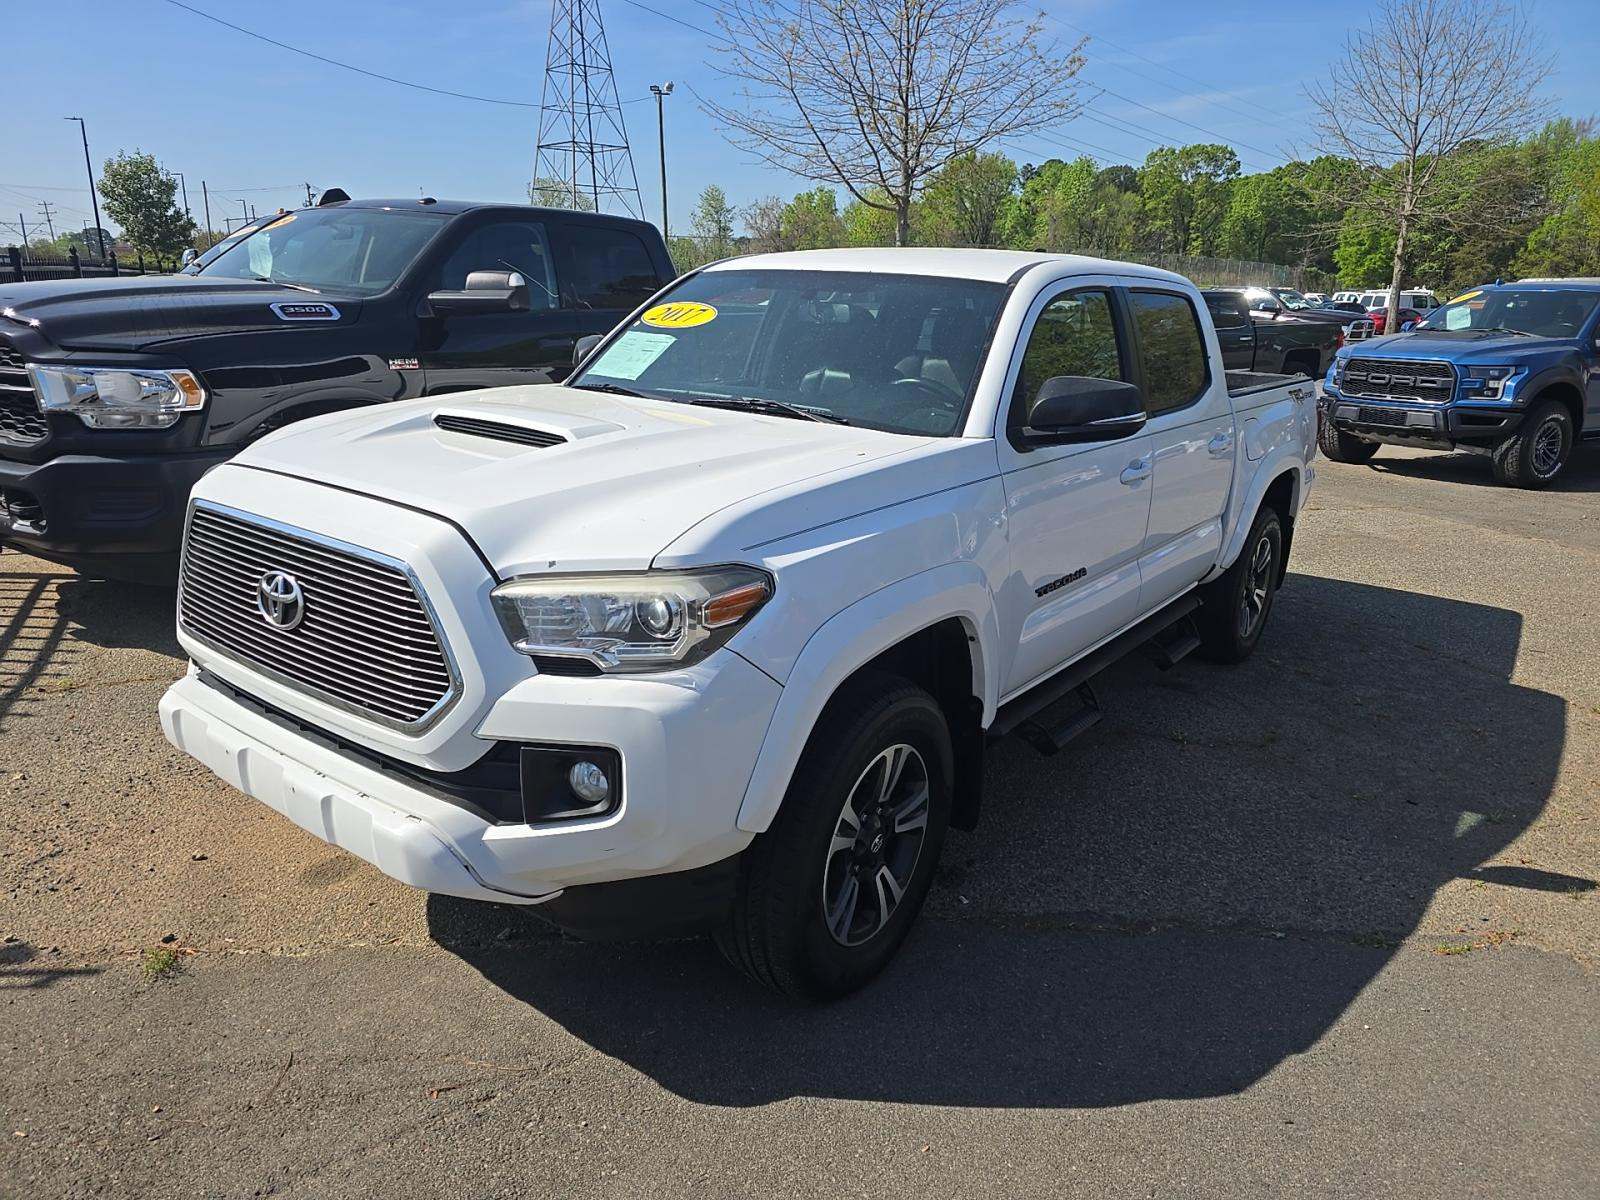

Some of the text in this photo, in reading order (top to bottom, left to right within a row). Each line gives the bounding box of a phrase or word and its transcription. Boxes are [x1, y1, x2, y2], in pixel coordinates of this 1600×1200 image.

[284, 306, 327, 314] 3500
[647, 306, 710, 323] 2017
[388, 358, 419, 366] HEMI
[1343, 370, 1443, 387] FORD
[1034, 566, 1088, 598] TACOMA
